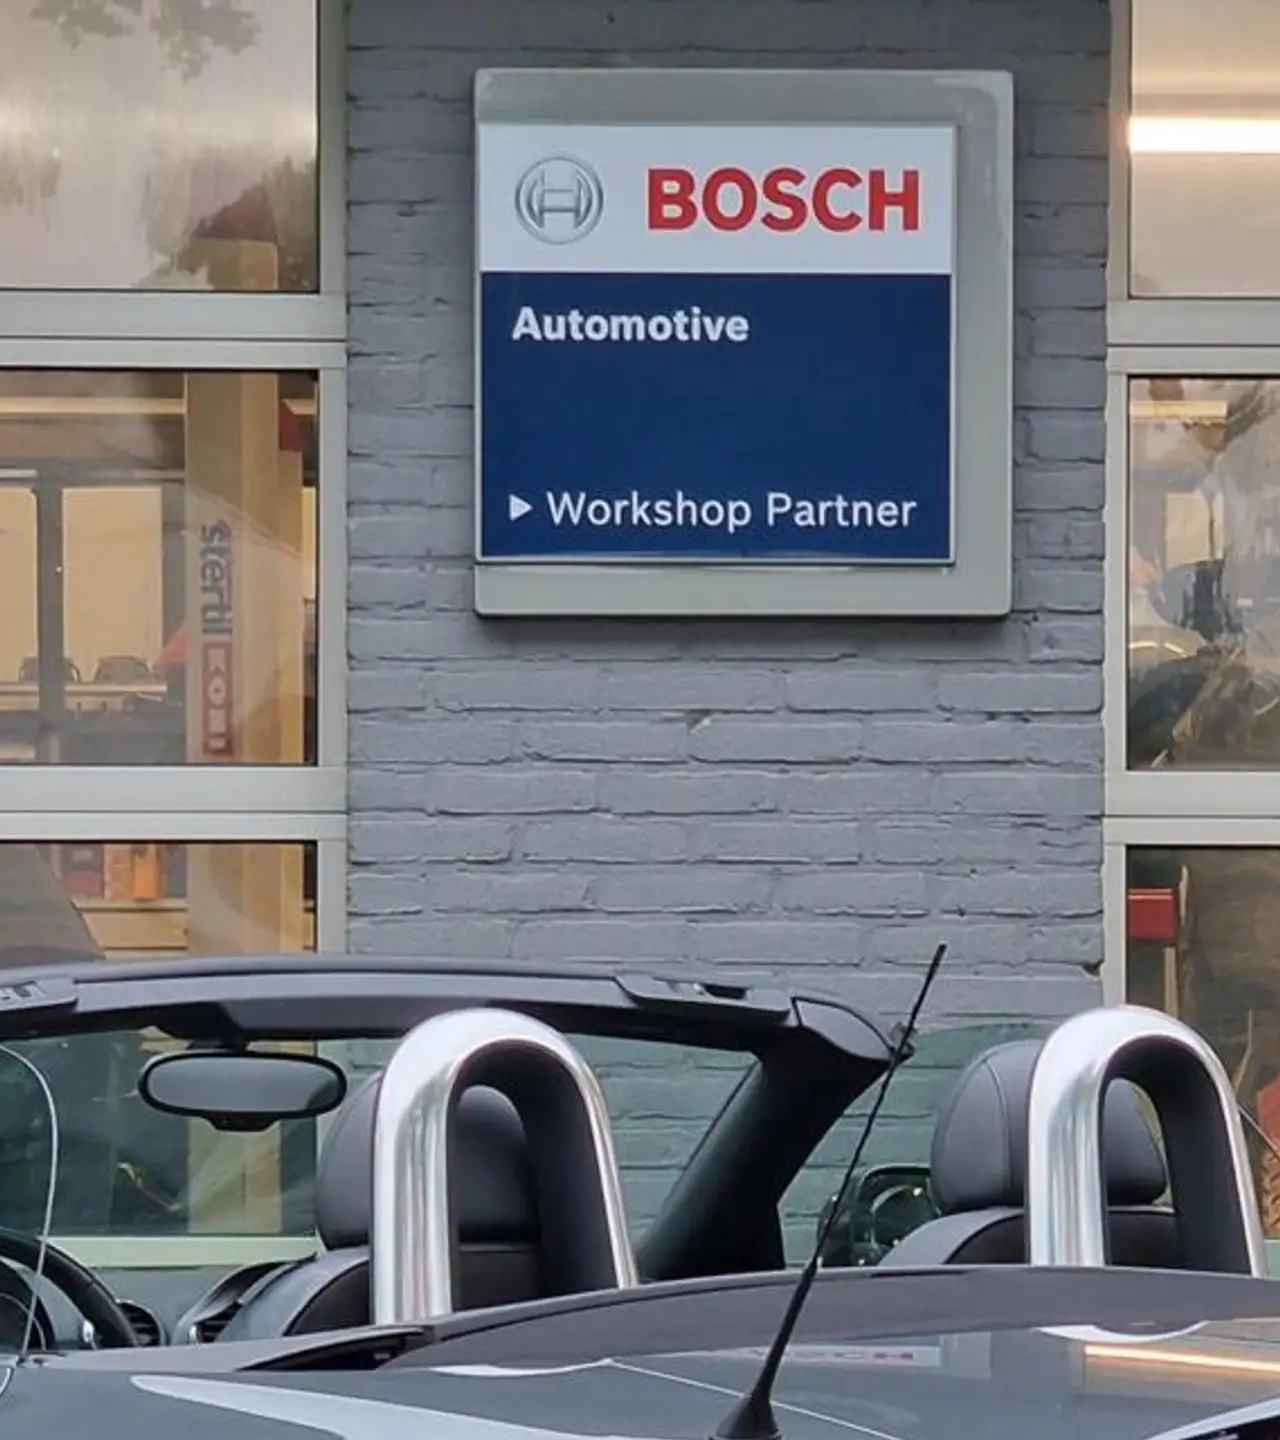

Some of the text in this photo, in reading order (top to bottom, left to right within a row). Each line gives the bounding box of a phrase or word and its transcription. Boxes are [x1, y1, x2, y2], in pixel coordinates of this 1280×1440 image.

[646, 166, 920, 232] BOSCH
[511, 306, 750, 342] Automotive
[546, 490, 917, 533] Workshop Partner
